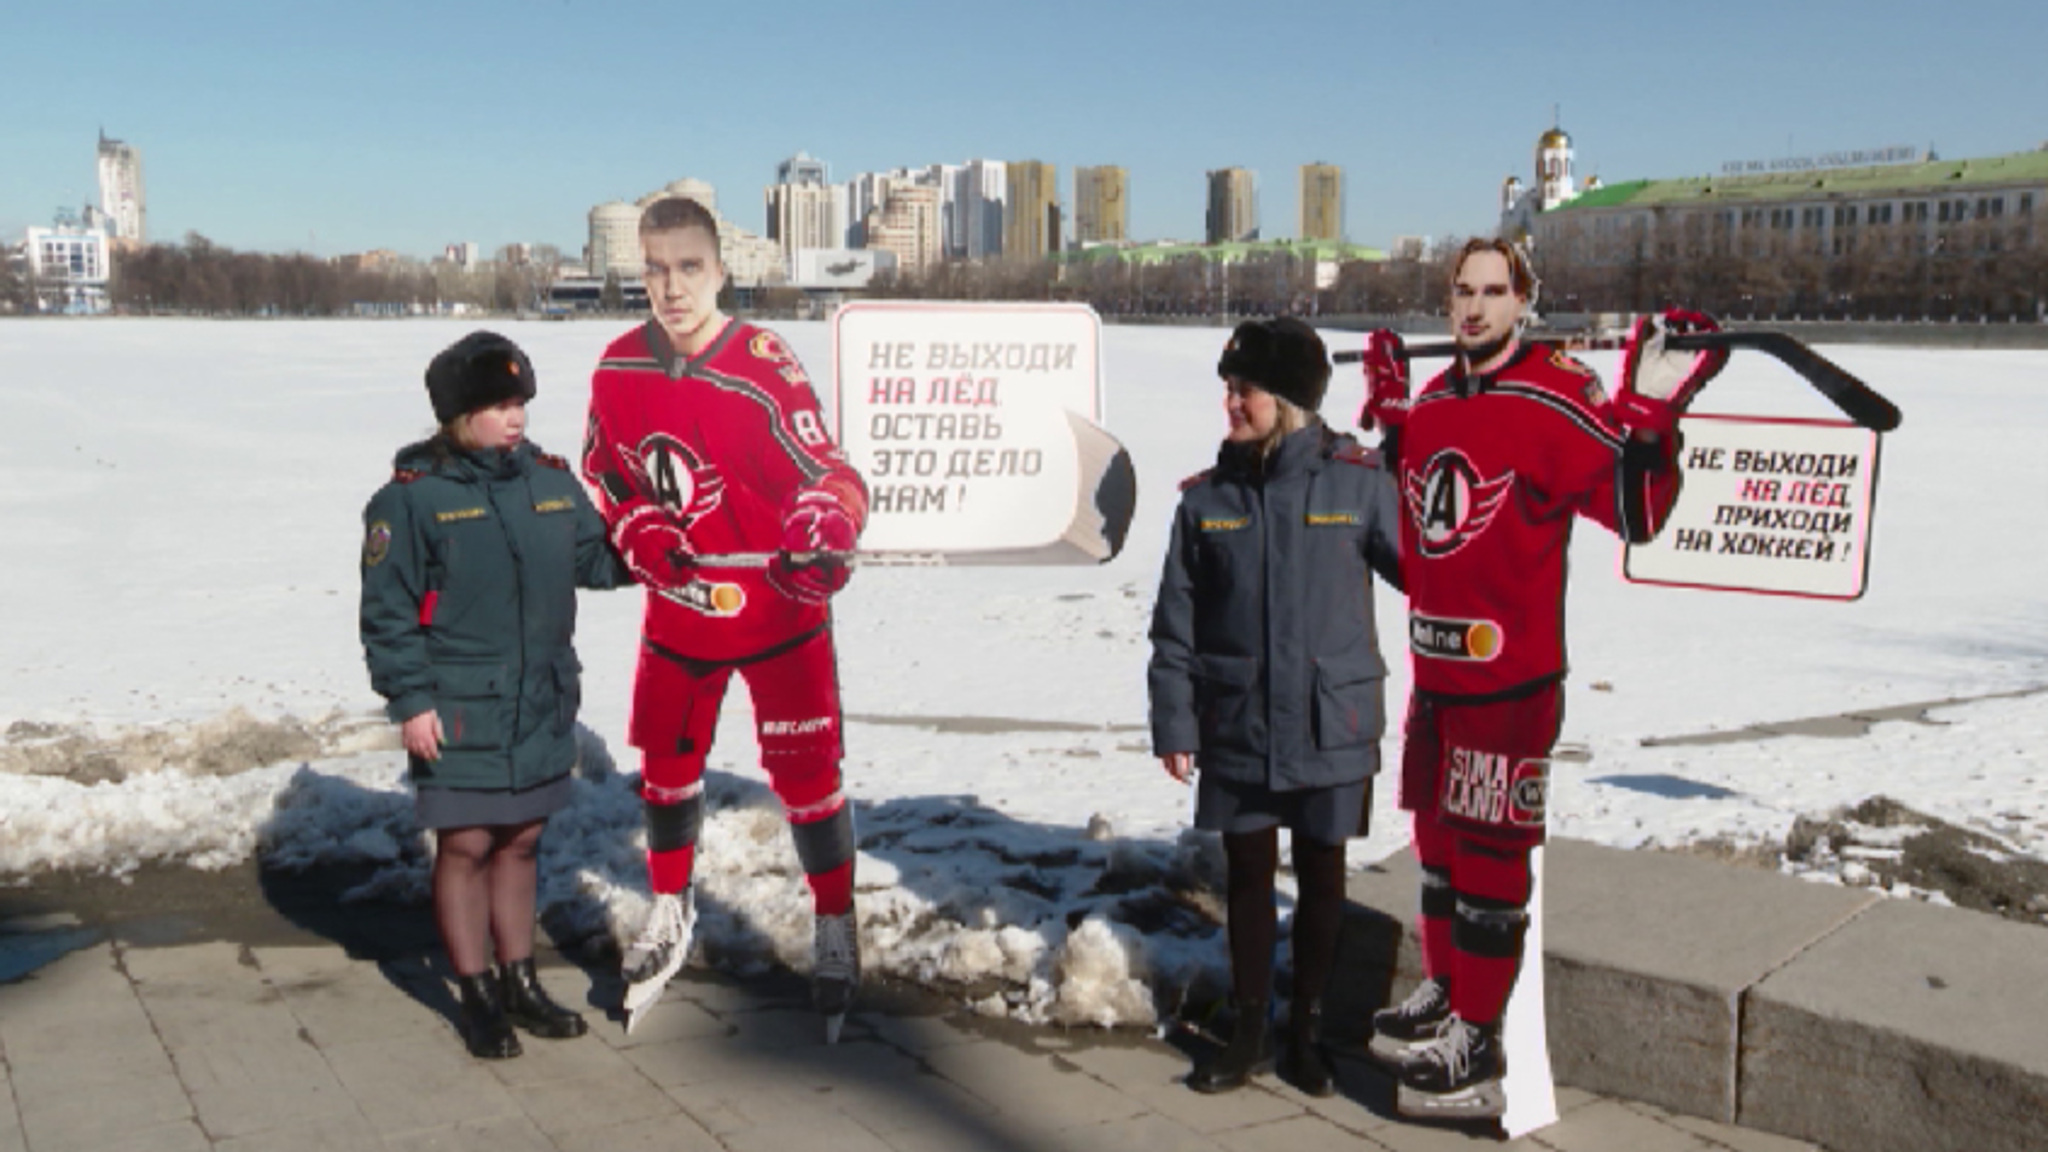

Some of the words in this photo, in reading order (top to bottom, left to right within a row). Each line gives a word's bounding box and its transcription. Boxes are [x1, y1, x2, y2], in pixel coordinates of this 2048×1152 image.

[868, 342, 914, 370] НЕ
[926, 342, 1078, 373] ВЫХОДИ
[868, 376, 915, 404] НА
[869, 413, 1003, 441] ОСТАВЬ
[871, 449, 937, 477] ЭТО
[944, 449, 1043, 479] ДЕЛО
[1687, 447, 1726, 470] НЕ
[1733, 449, 1858, 479] ВЫХОДИ
[870, 484, 948, 513] НАМ
[1740, 478, 1782, 502] НА
[1713, 505, 1853, 535] ПРИХОДИ
[1675, 528, 1713, 552] НА
[1718, 531, 1834, 563] ХОККЕЙ
[1451, 747, 1508, 790] SIMA
[1447, 778, 1507, 823] LAND
